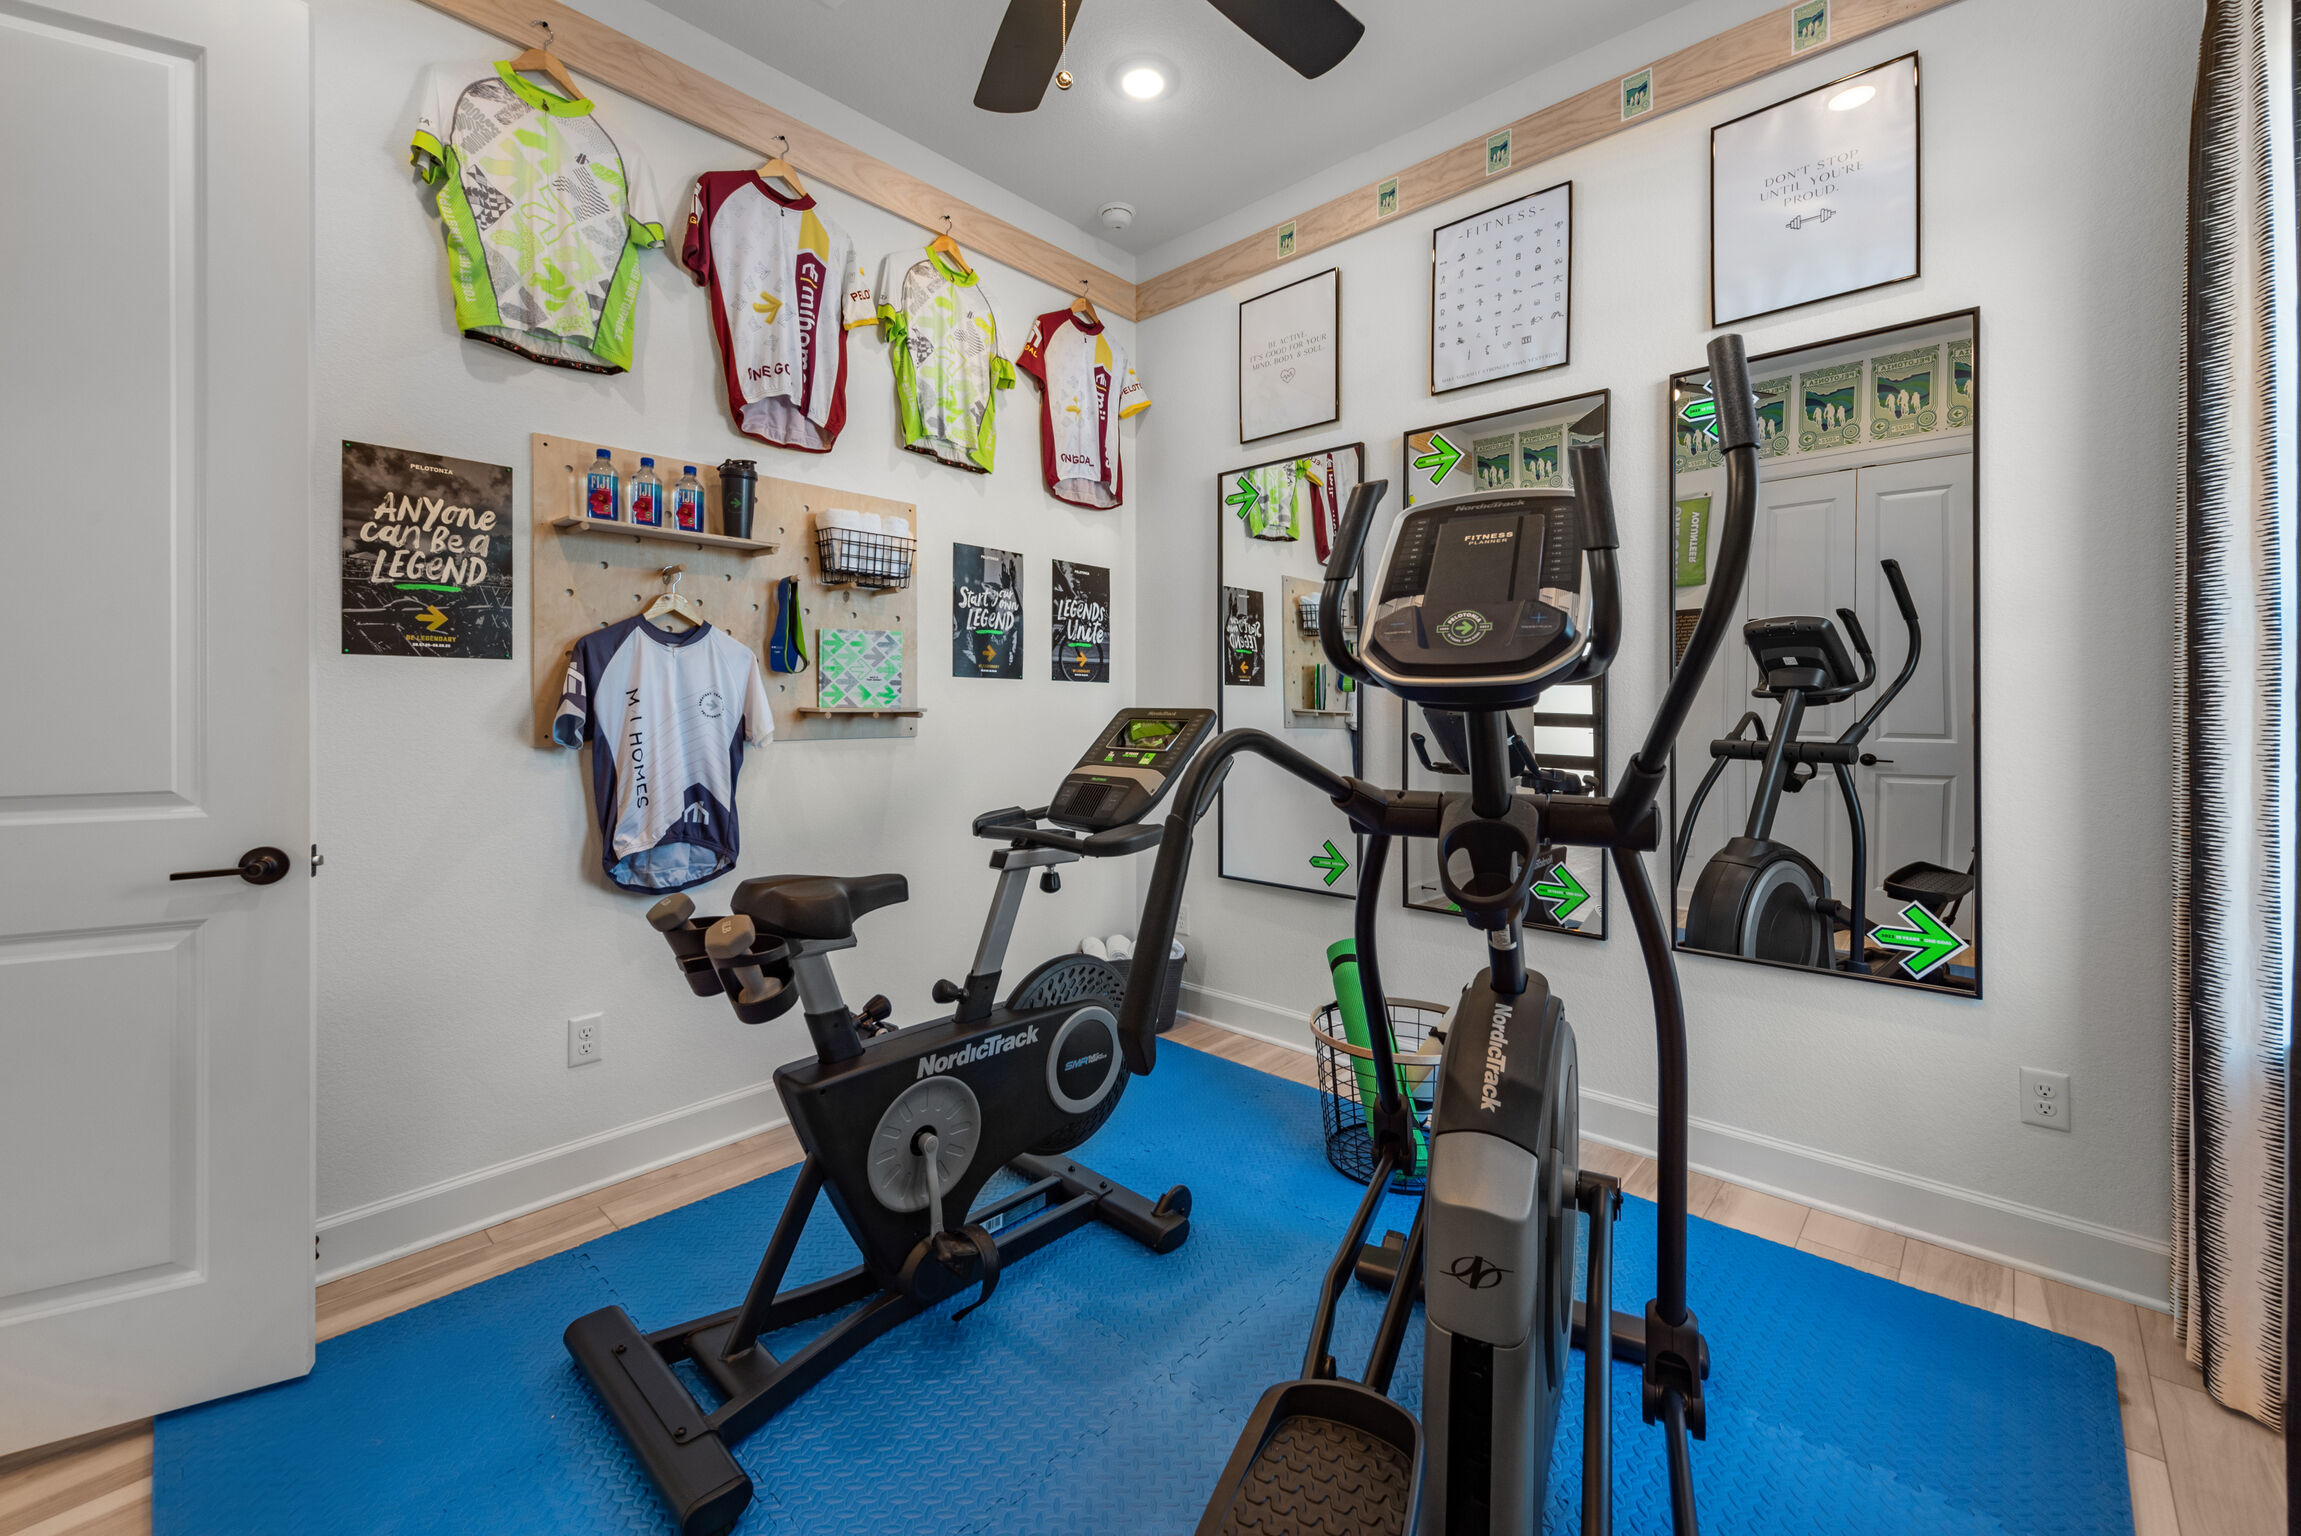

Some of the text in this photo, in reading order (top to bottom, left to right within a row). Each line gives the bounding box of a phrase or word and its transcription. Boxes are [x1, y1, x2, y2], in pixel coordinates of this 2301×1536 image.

[1765, 149, 1859, 187] DON'T STOP
[1760, 162, 1863, 202] UNTIL YOU'RE
[1783, 184, 1839, 207] PROUD.
[1290, 341, 1304, 350] FOR
[1306, 333, 1327, 344] YOUR
[410, 464, 453, 475] PELOTONIA
[590, 475, 610, 490] FIJI
[1455, 501, 1525, 512] NordicTrack
[360, 522, 421, 548] can
[468, 534, 490, 558] a
[1464, 532, 1514, 542] FITNESS
[958, 586, 988, 608] Start
[1448, 612, 1482, 624] PELOTONIA
[1067, 620, 1104, 644] Unite
[629, 732, 649, 808] HOMES
[916, 1024, 1039, 1080] NordicTrack
[1480, 1002, 1512, 1114] NordicTrack
